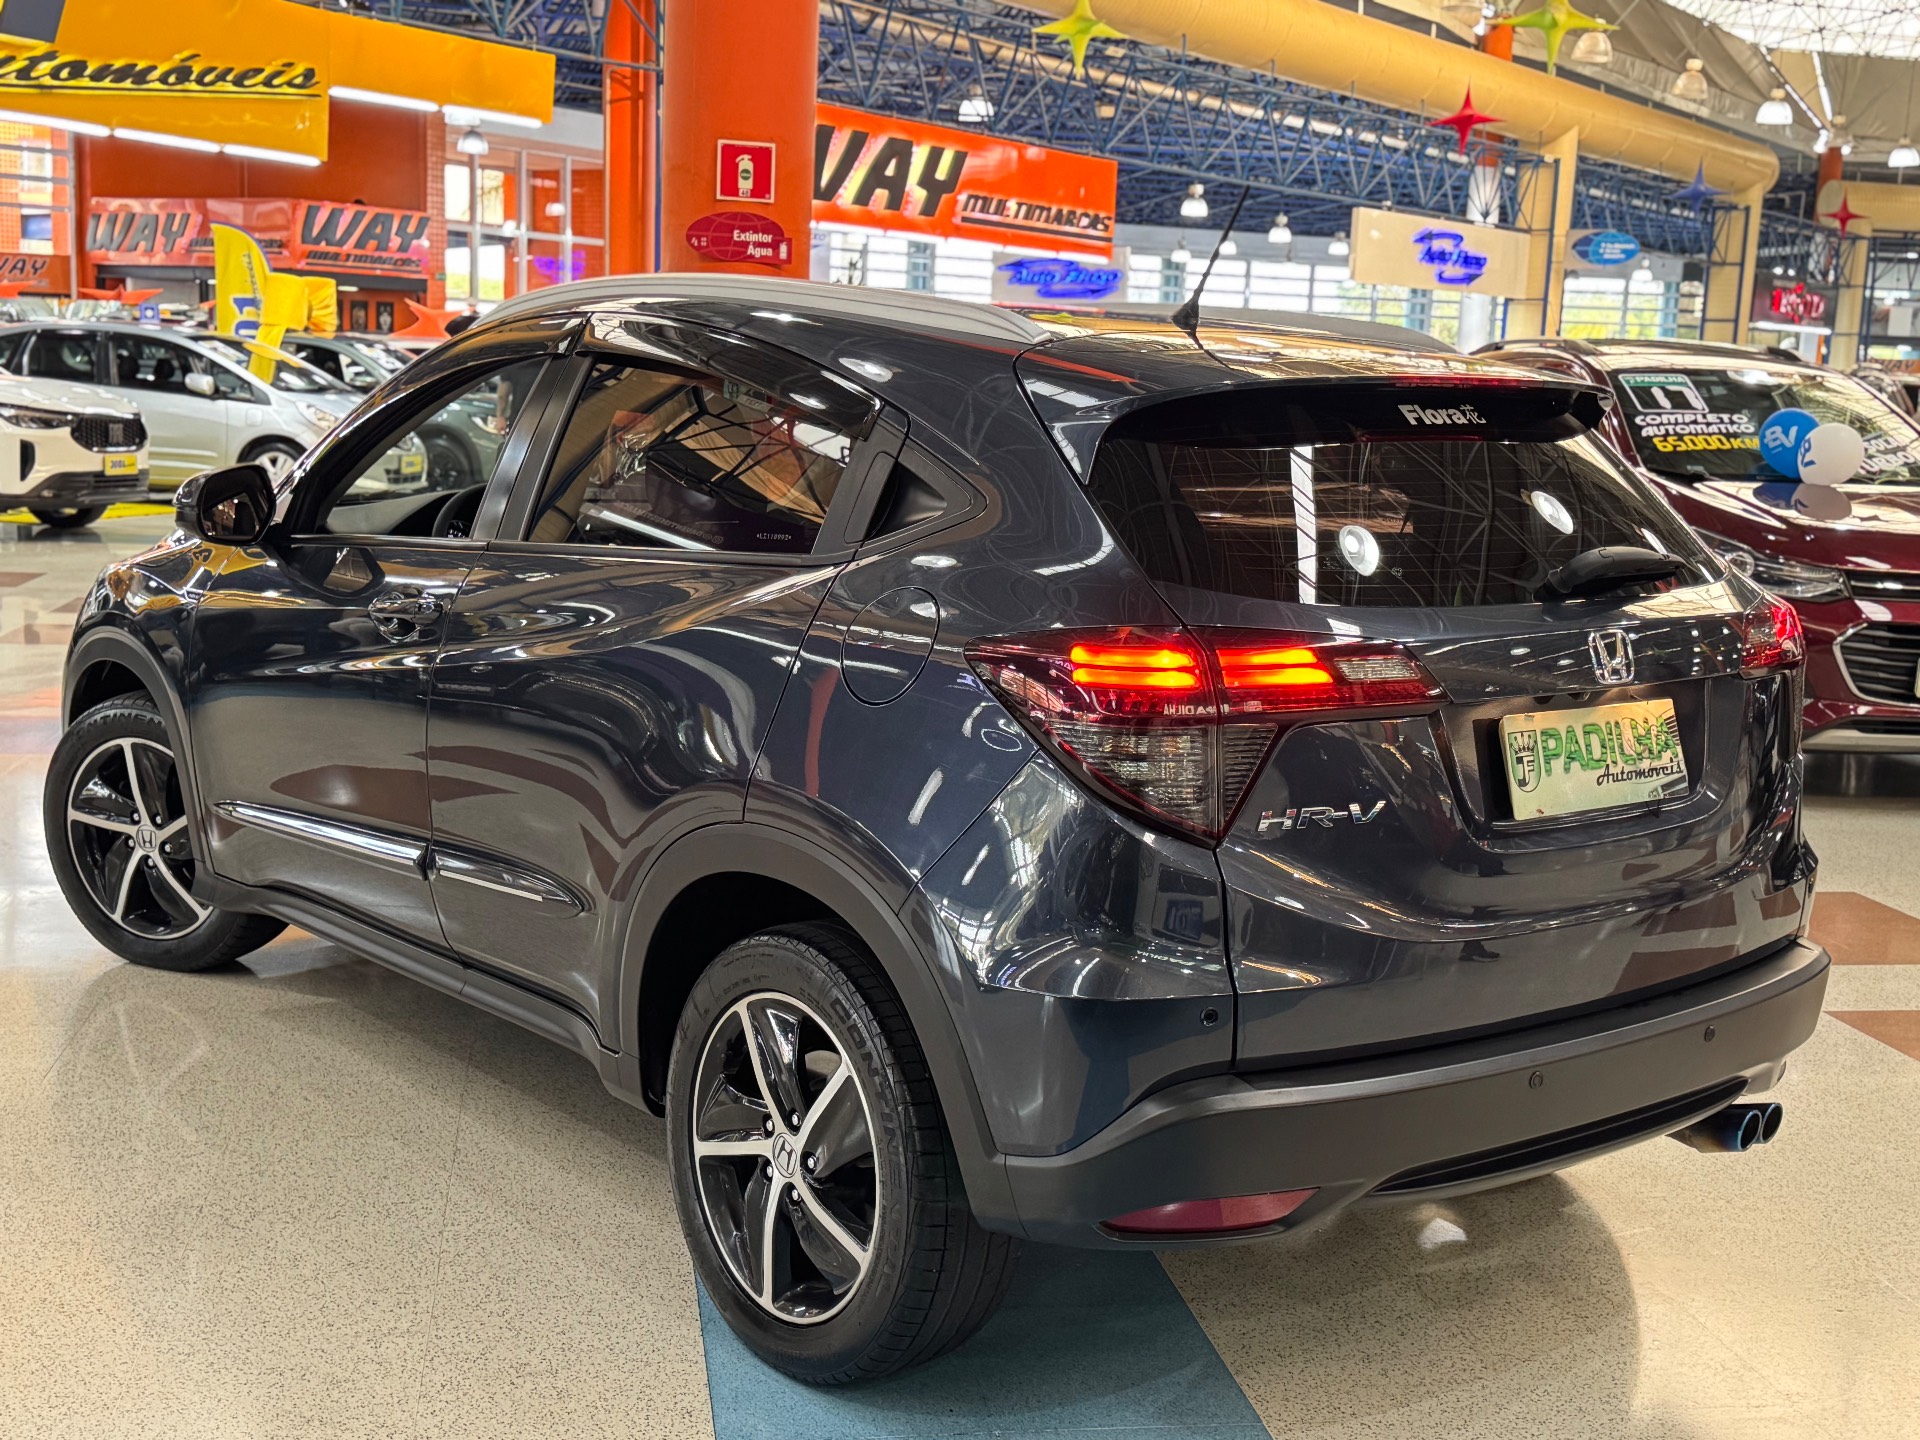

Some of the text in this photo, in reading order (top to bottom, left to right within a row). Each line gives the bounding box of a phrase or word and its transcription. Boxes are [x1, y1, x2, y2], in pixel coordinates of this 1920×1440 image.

[86, 212, 191, 252] WAY
[301, 204, 430, 253] WAY
[733, 230, 773, 243] Extintor
[747, 242, 773, 258] Água
[1397, 404, 1470, 426] Flora
[1634, 412, 1749, 427] COMPLETO
[1641, 423, 1756, 438] AUTOMATICO
[1540, 715, 1680, 778] PADILHA
[1596, 760, 1685, 787] Automóveis
[1257, 800, 1387, 832] HR-V
